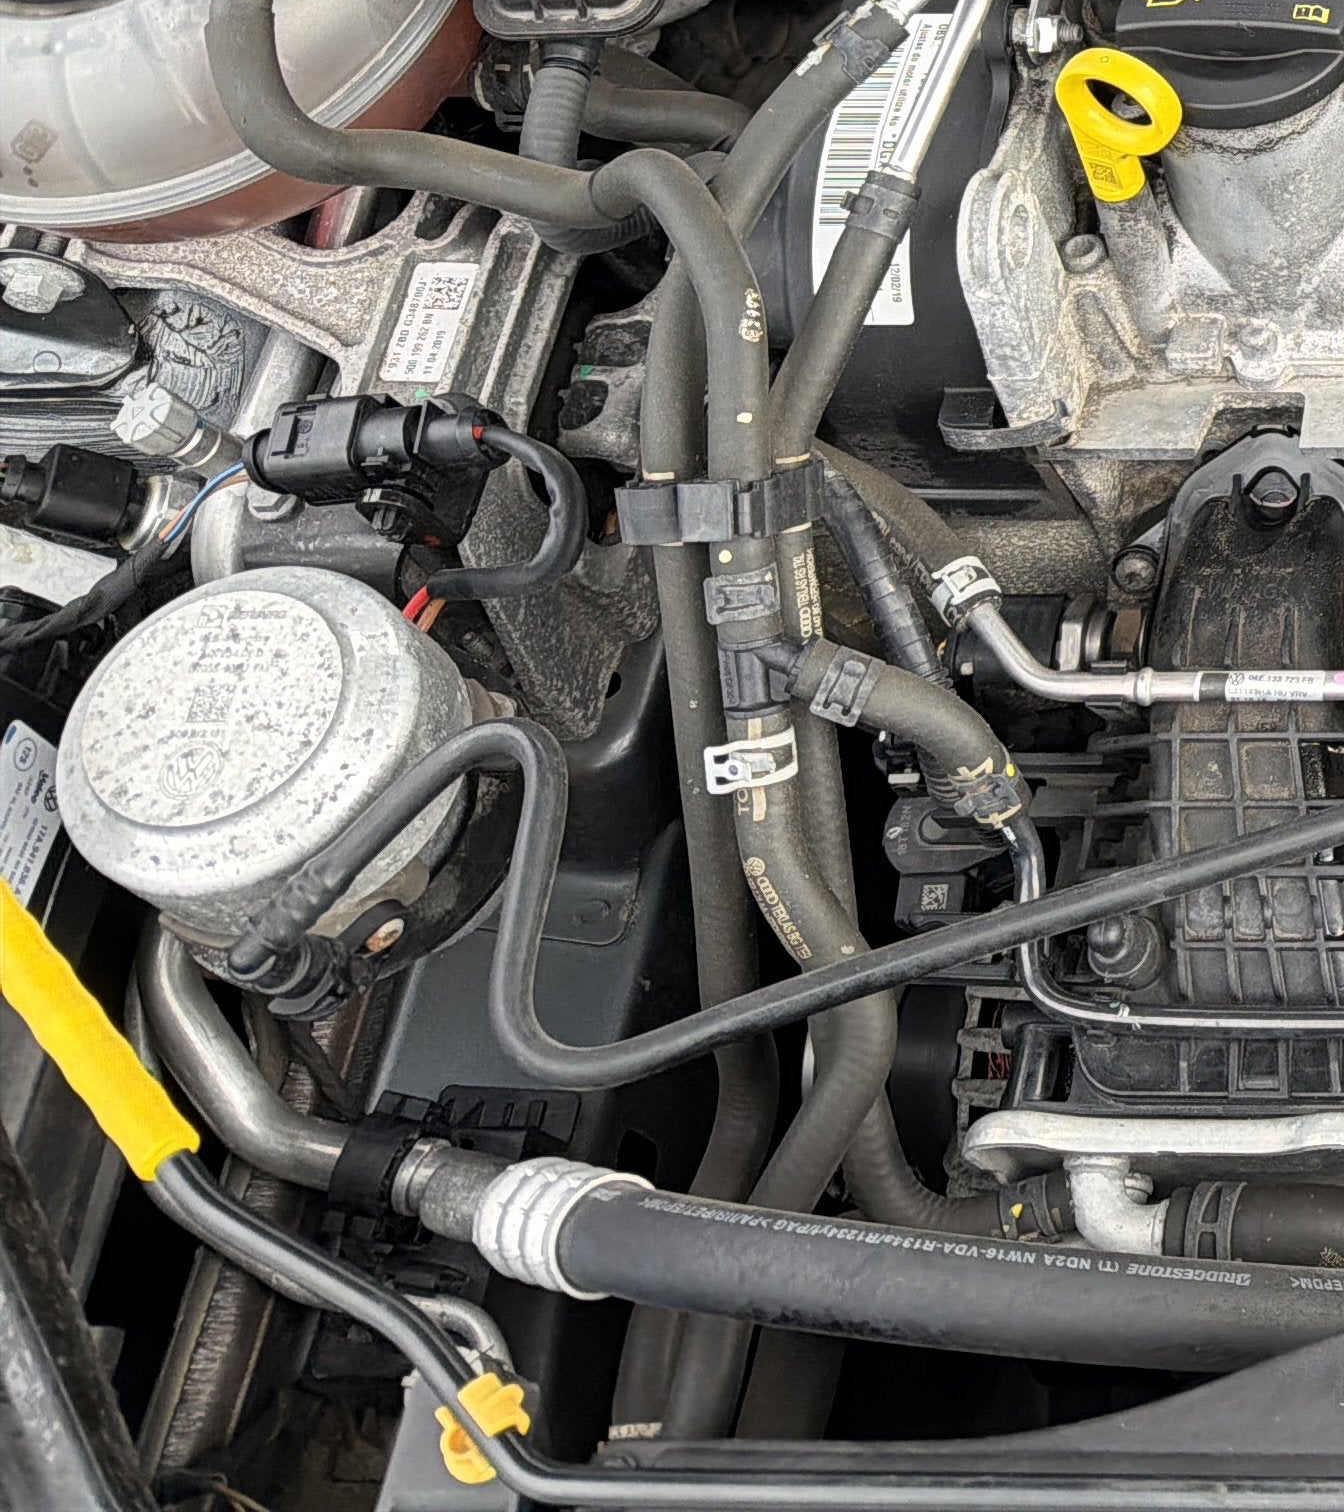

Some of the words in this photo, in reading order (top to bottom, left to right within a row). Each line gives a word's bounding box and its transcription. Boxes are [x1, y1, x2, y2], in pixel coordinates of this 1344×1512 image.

[891, 261, 903, 304] 12/02/19
[1043, 1254, 1092, 1270] ND2A
[1126, 1262, 1251, 1287] BRIDGESTONE
